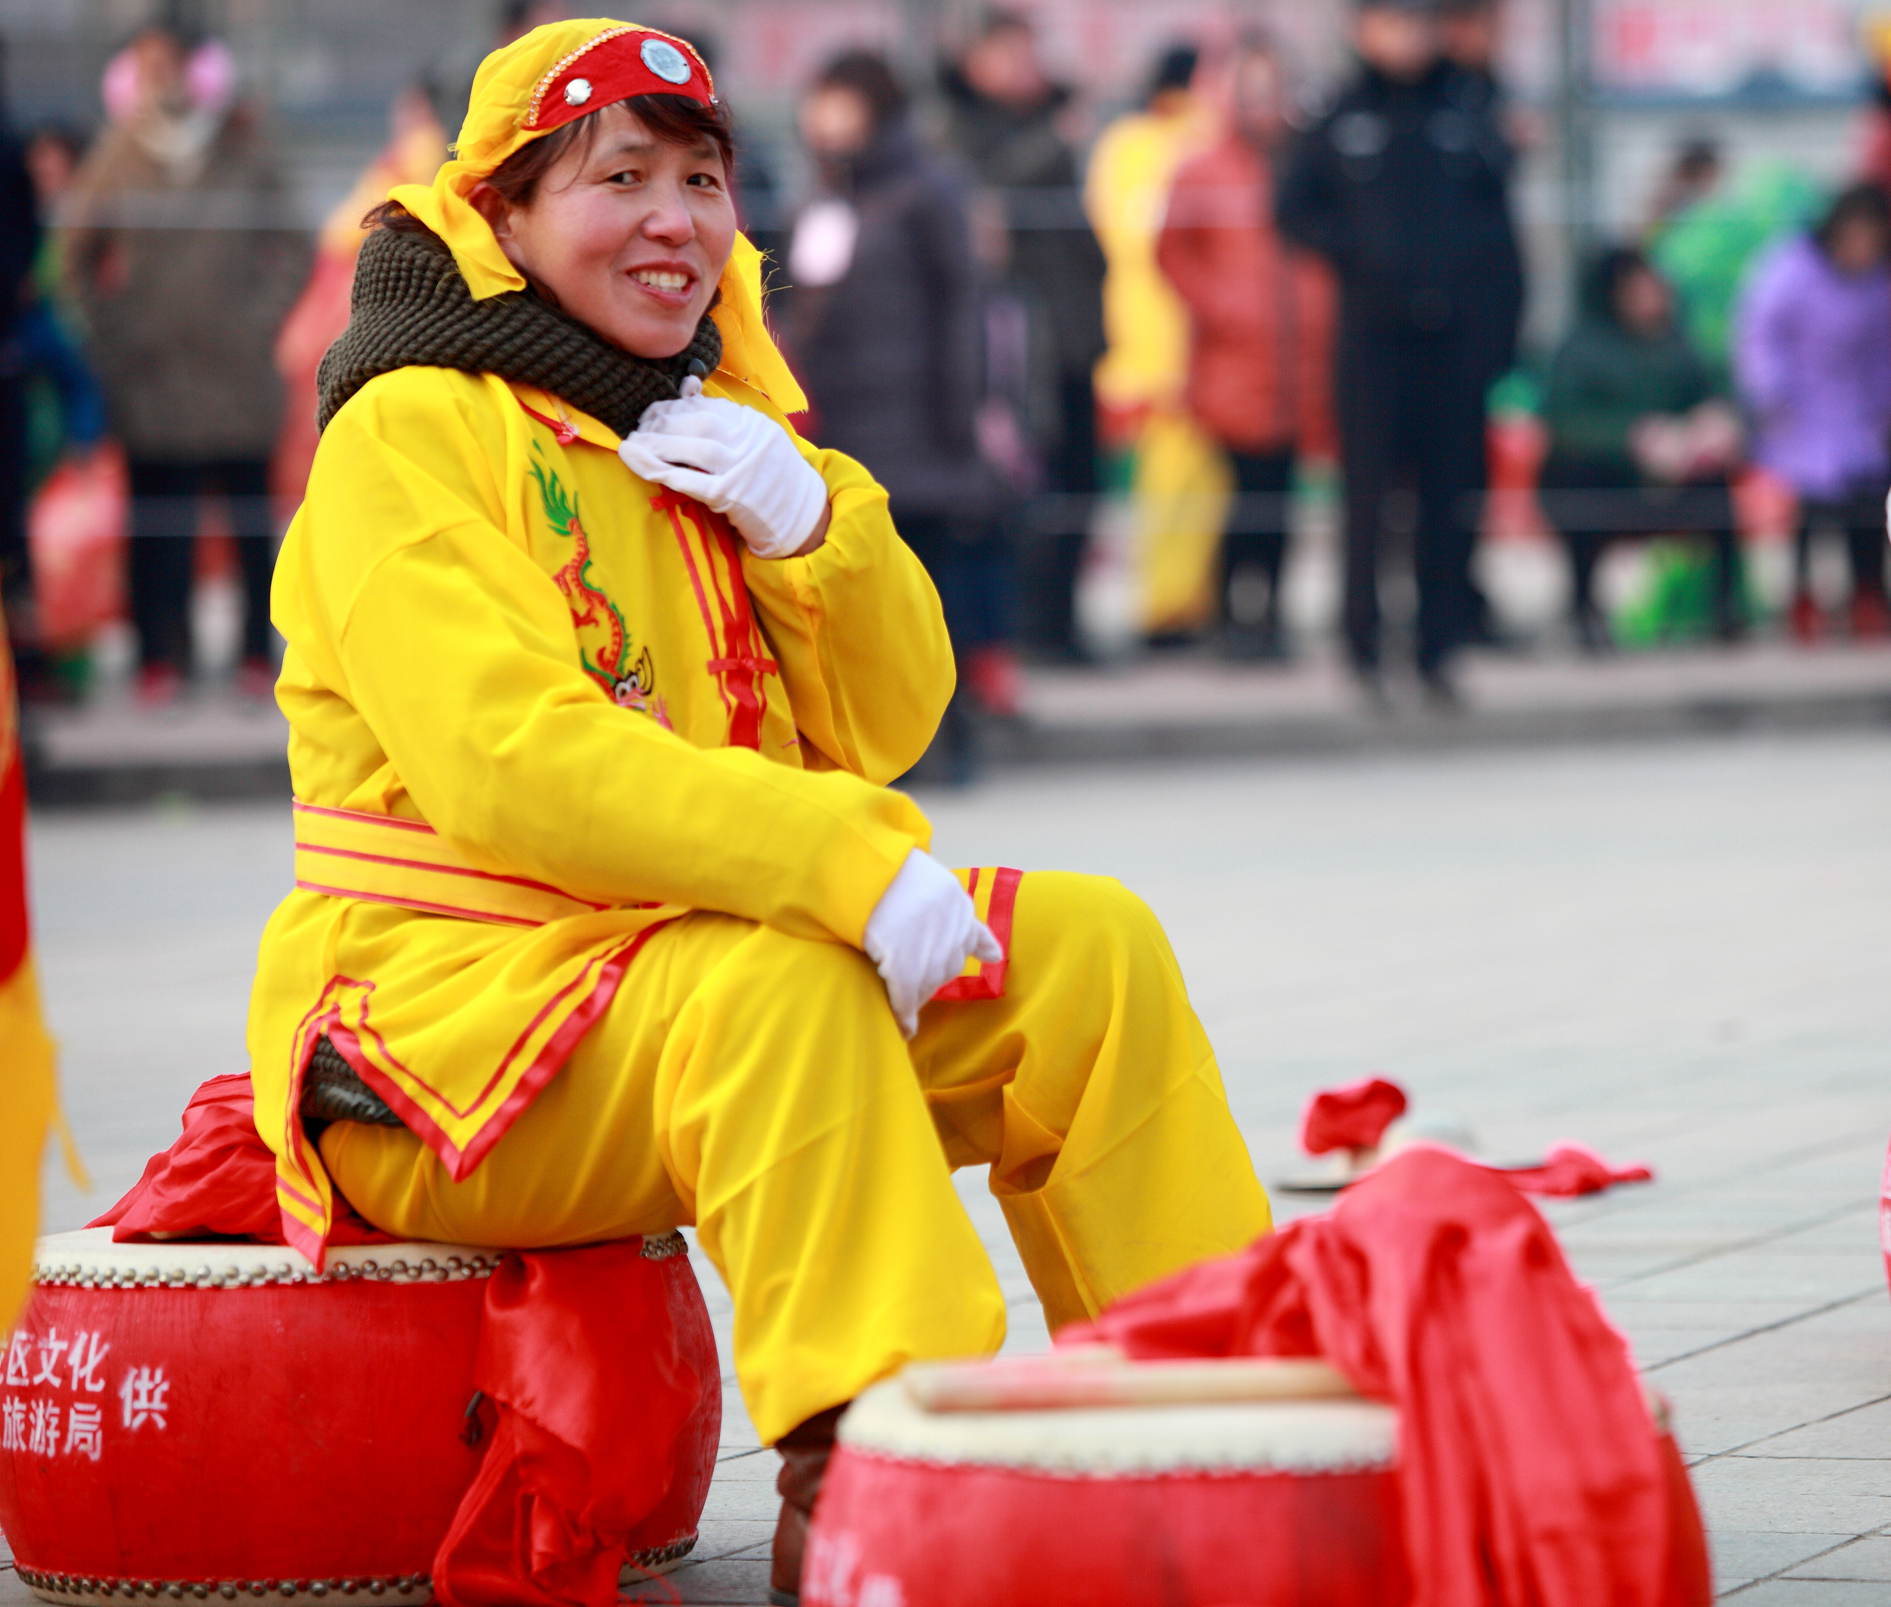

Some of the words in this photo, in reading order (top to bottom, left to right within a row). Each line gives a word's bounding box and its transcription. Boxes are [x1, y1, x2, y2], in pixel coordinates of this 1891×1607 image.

[0, 1328, 110, 1392] 区文化
[2, 1396, 103, 1461] 旅游局
[119, 1366, 169, 1430] 供
